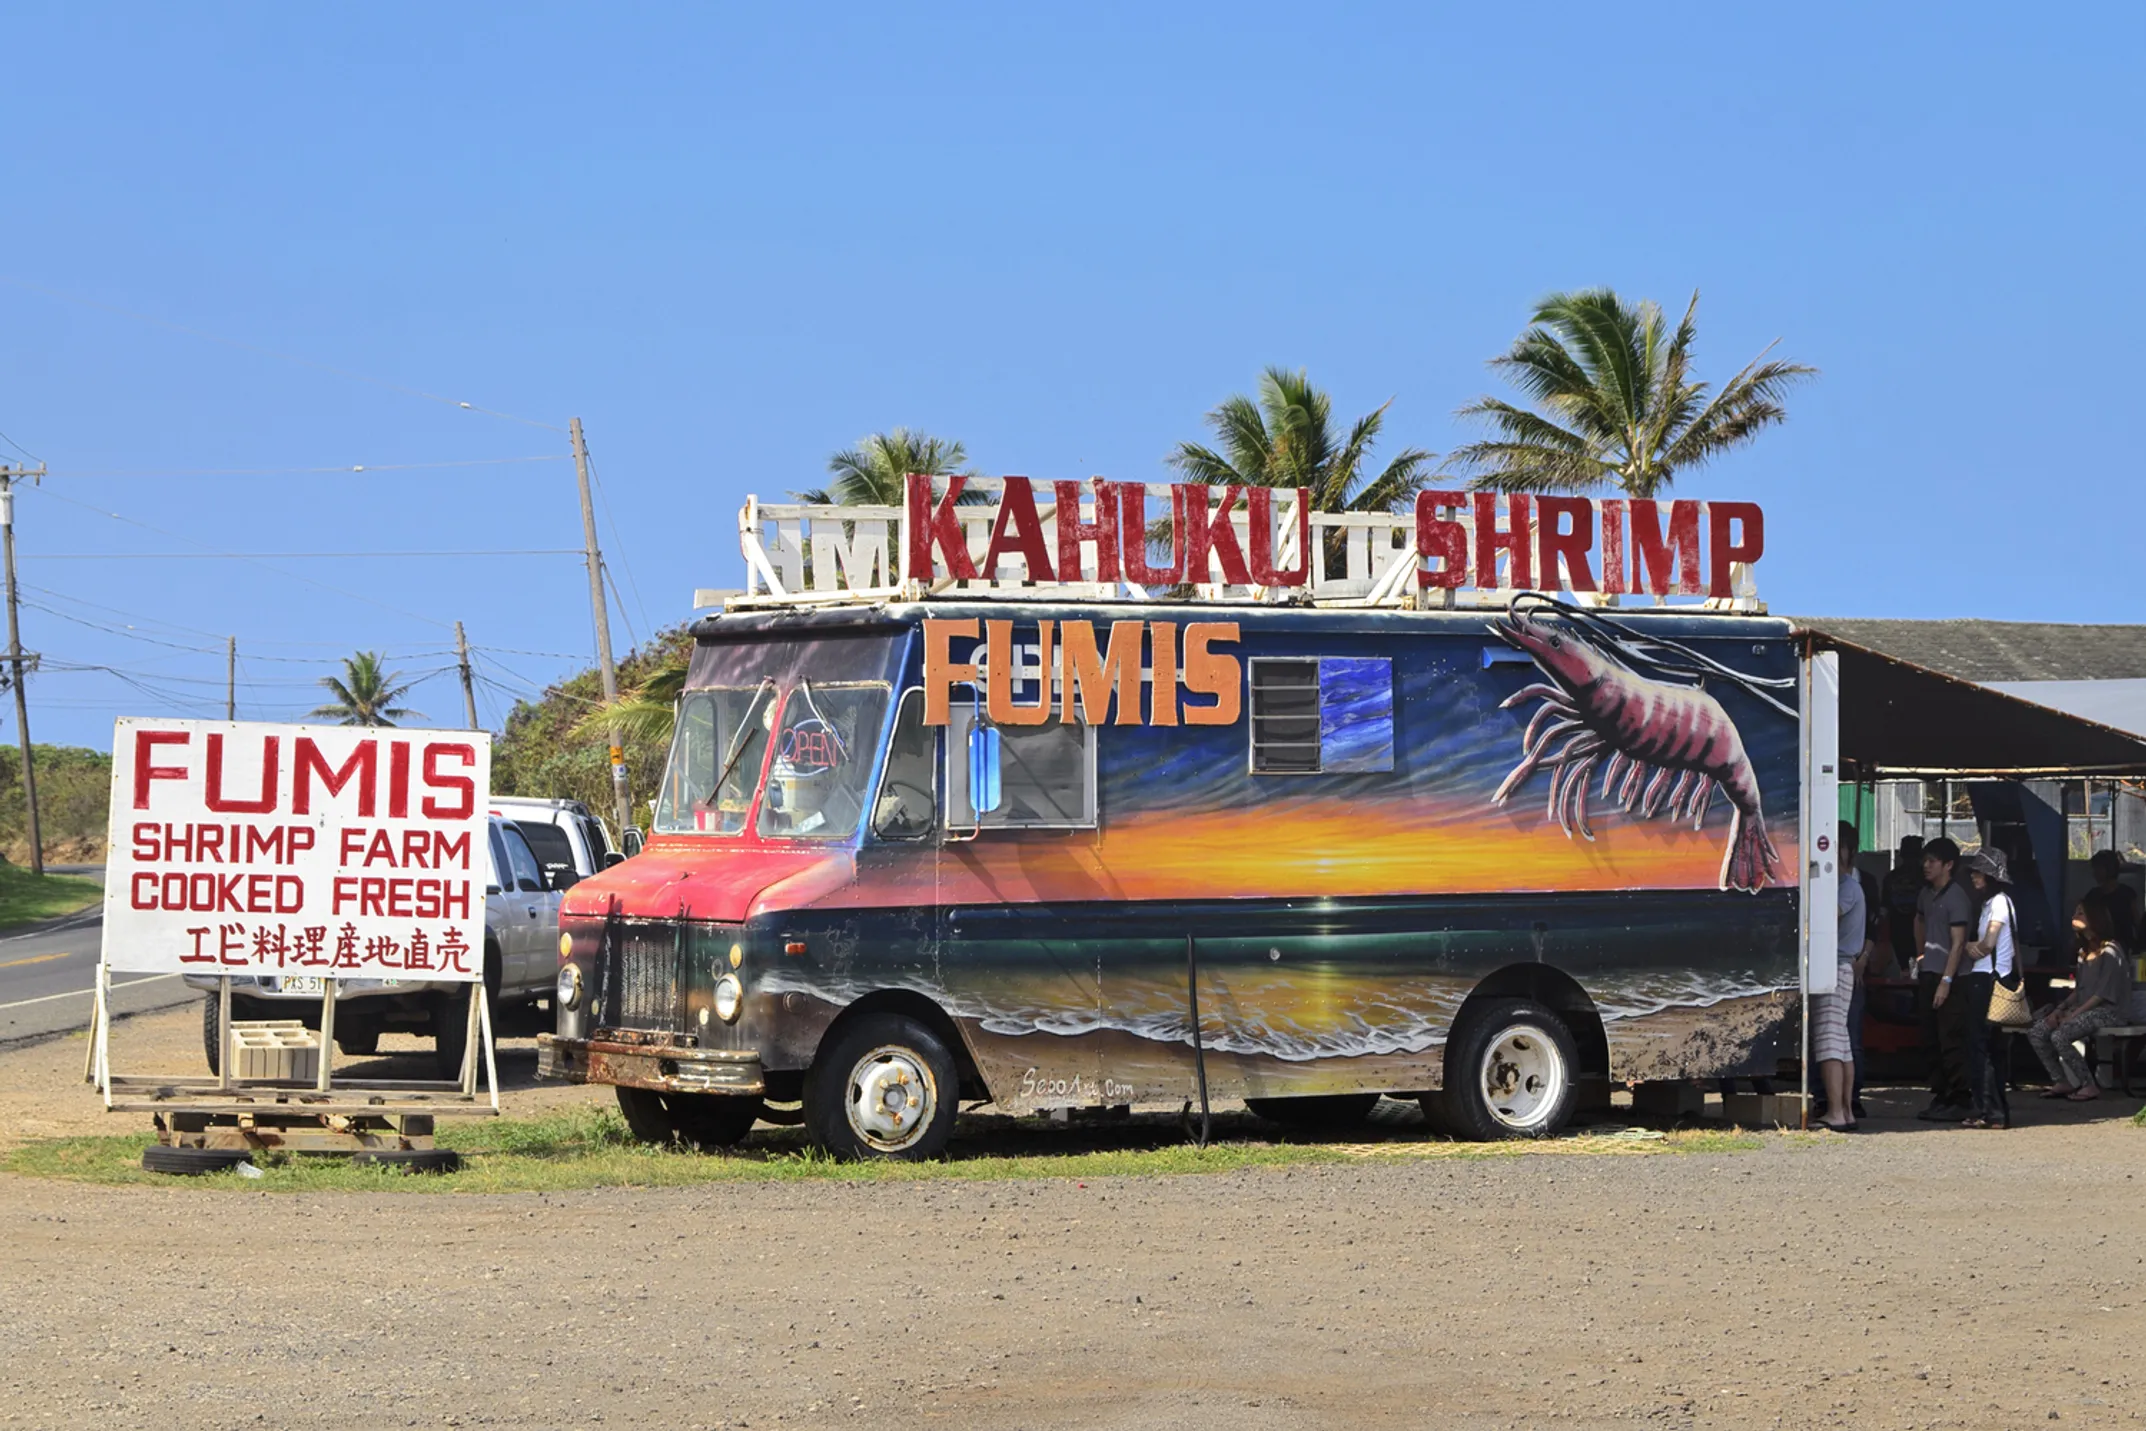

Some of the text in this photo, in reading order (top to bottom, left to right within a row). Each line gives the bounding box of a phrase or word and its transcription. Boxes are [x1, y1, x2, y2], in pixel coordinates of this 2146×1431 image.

[905, 473, 1310, 587] KAHUKU
[1415, 490, 1764, 598] SHRIMP
[922, 617, 1242, 727] FUMIS
[780, 727, 838, 767] OPEN
[134, 731, 476, 821] FUMIS
[132, 822, 471, 870] SHRIMP FARM
[131, 871, 470, 920] COOKED FRESH
[179, 921, 472, 973] エビ料理産地直売
